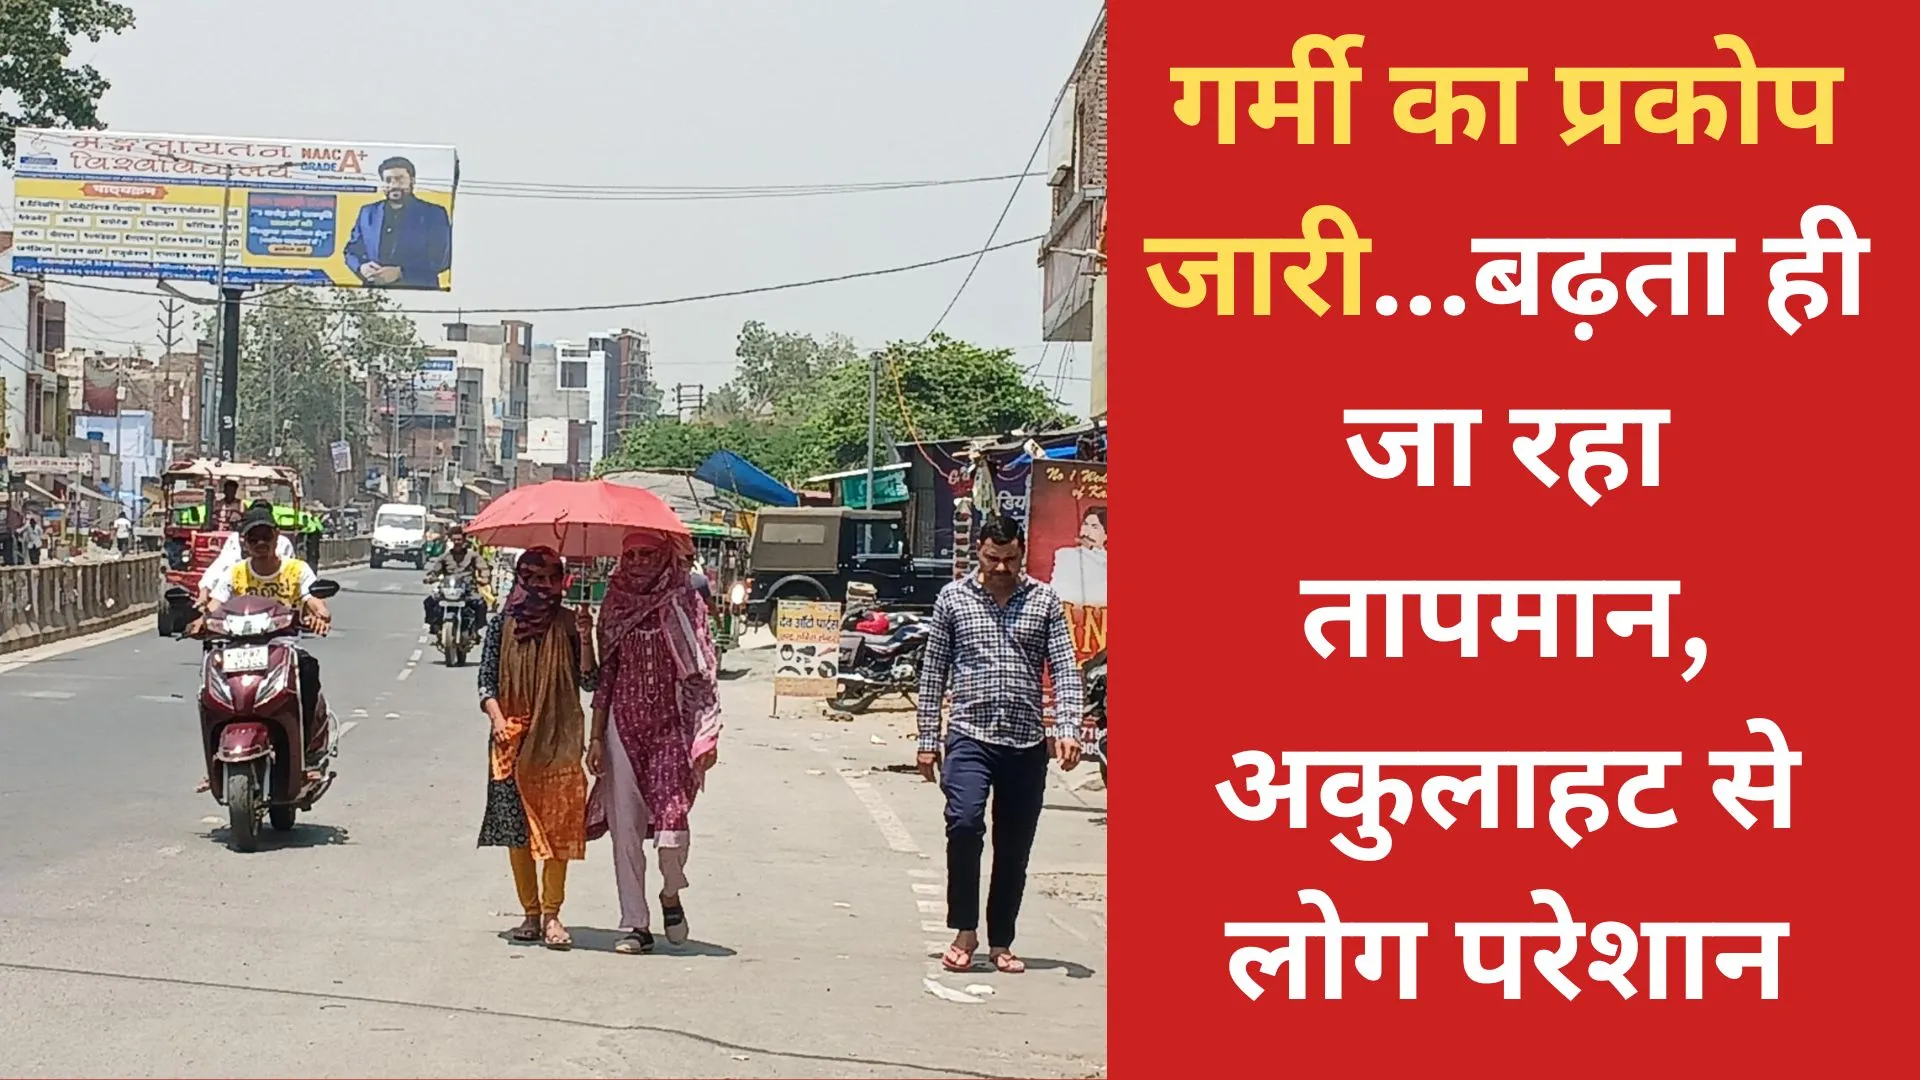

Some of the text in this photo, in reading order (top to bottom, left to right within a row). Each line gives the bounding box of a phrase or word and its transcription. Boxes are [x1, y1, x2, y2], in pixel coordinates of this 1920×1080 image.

[302, 147, 341, 160] NAAC
[300, 160, 338, 173] GRADE
[1046, 467, 1064, 481] No
[1070, 469, 1077, 481] 1
